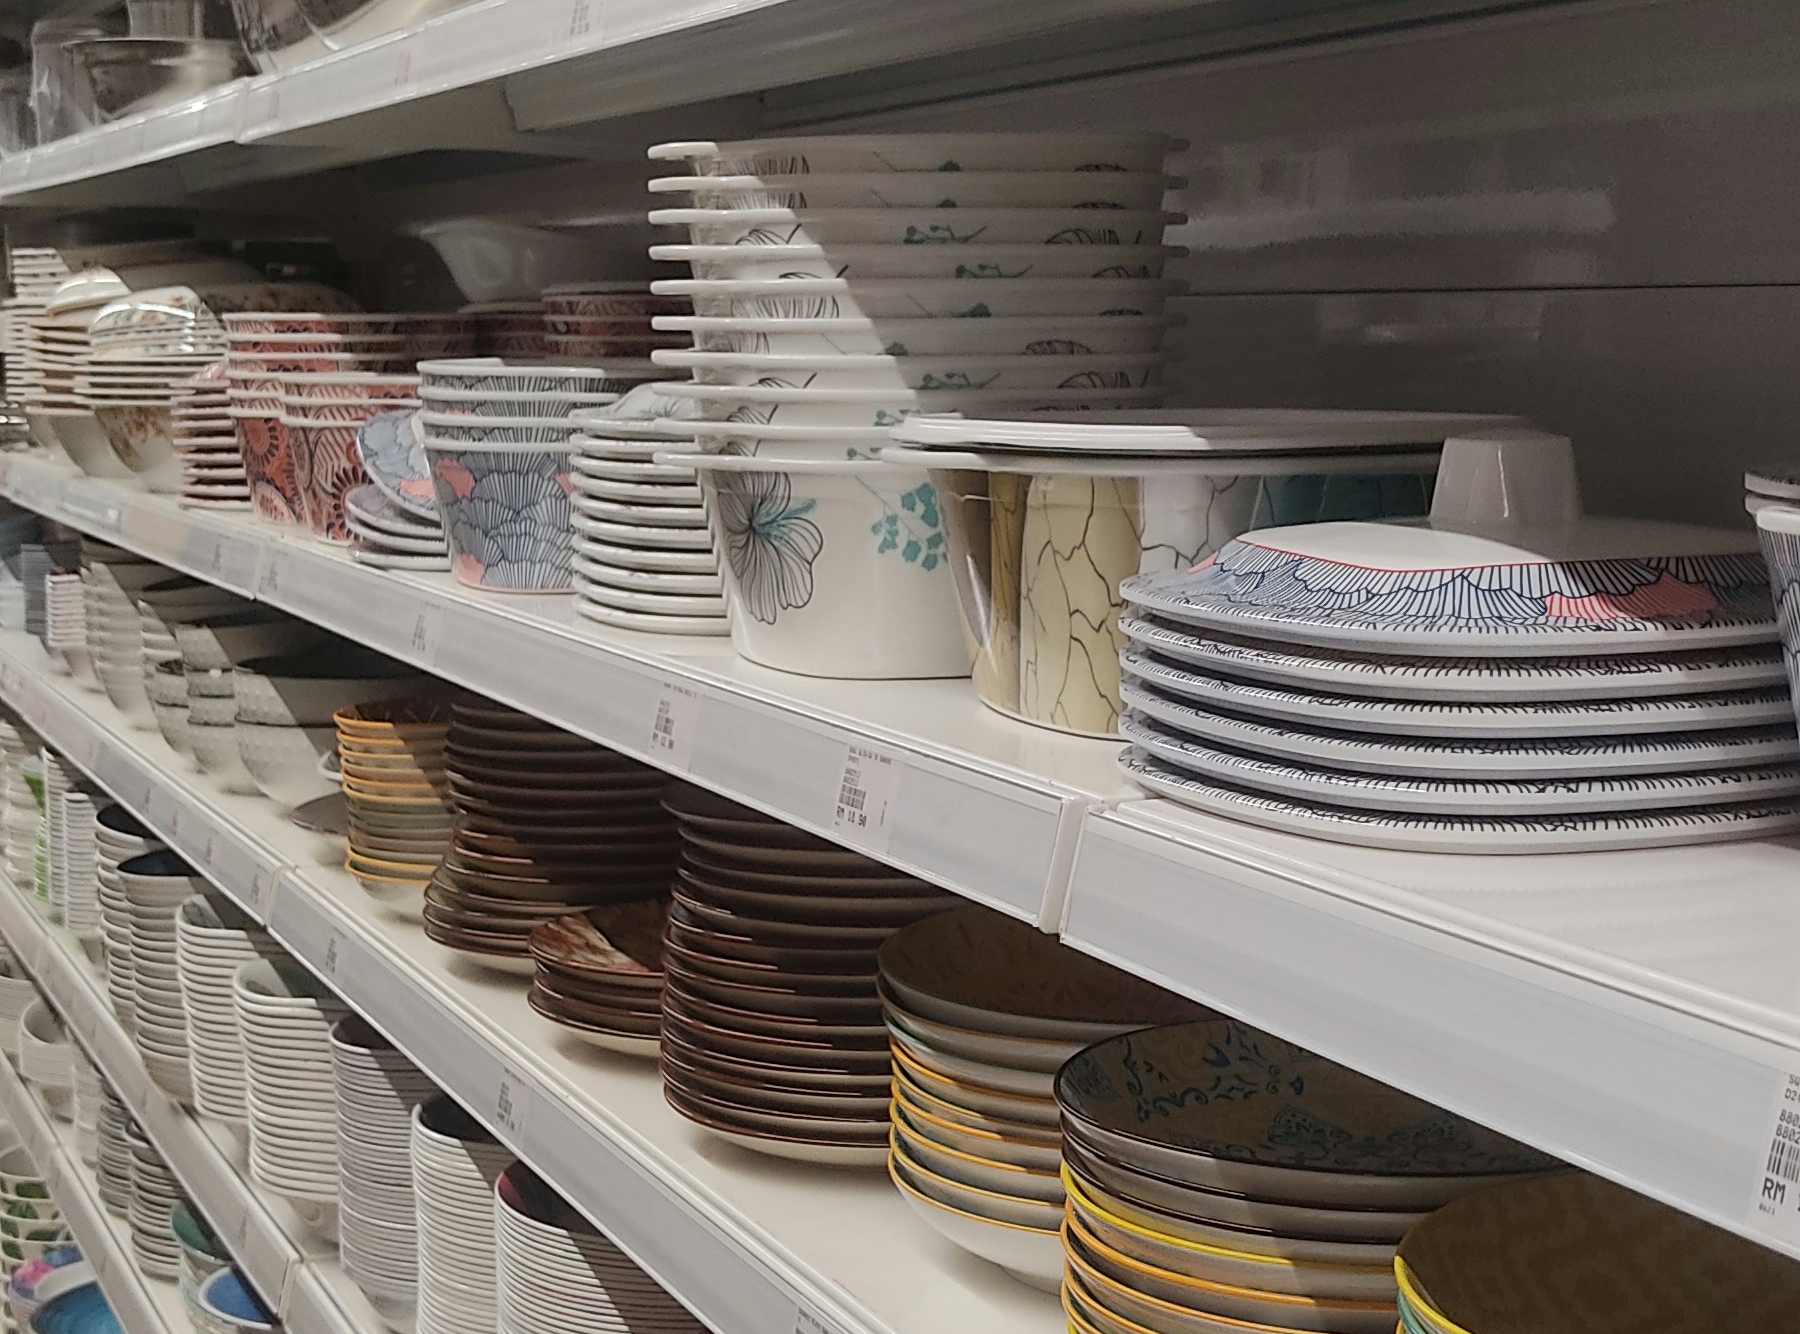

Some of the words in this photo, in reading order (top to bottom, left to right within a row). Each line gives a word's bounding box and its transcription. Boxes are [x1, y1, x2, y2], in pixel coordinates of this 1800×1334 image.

[1784, 1088, 1800, 1104] D2
[1779, 1109, 1800, 1128] 880
[1762, 1176, 1787, 1205] RM
